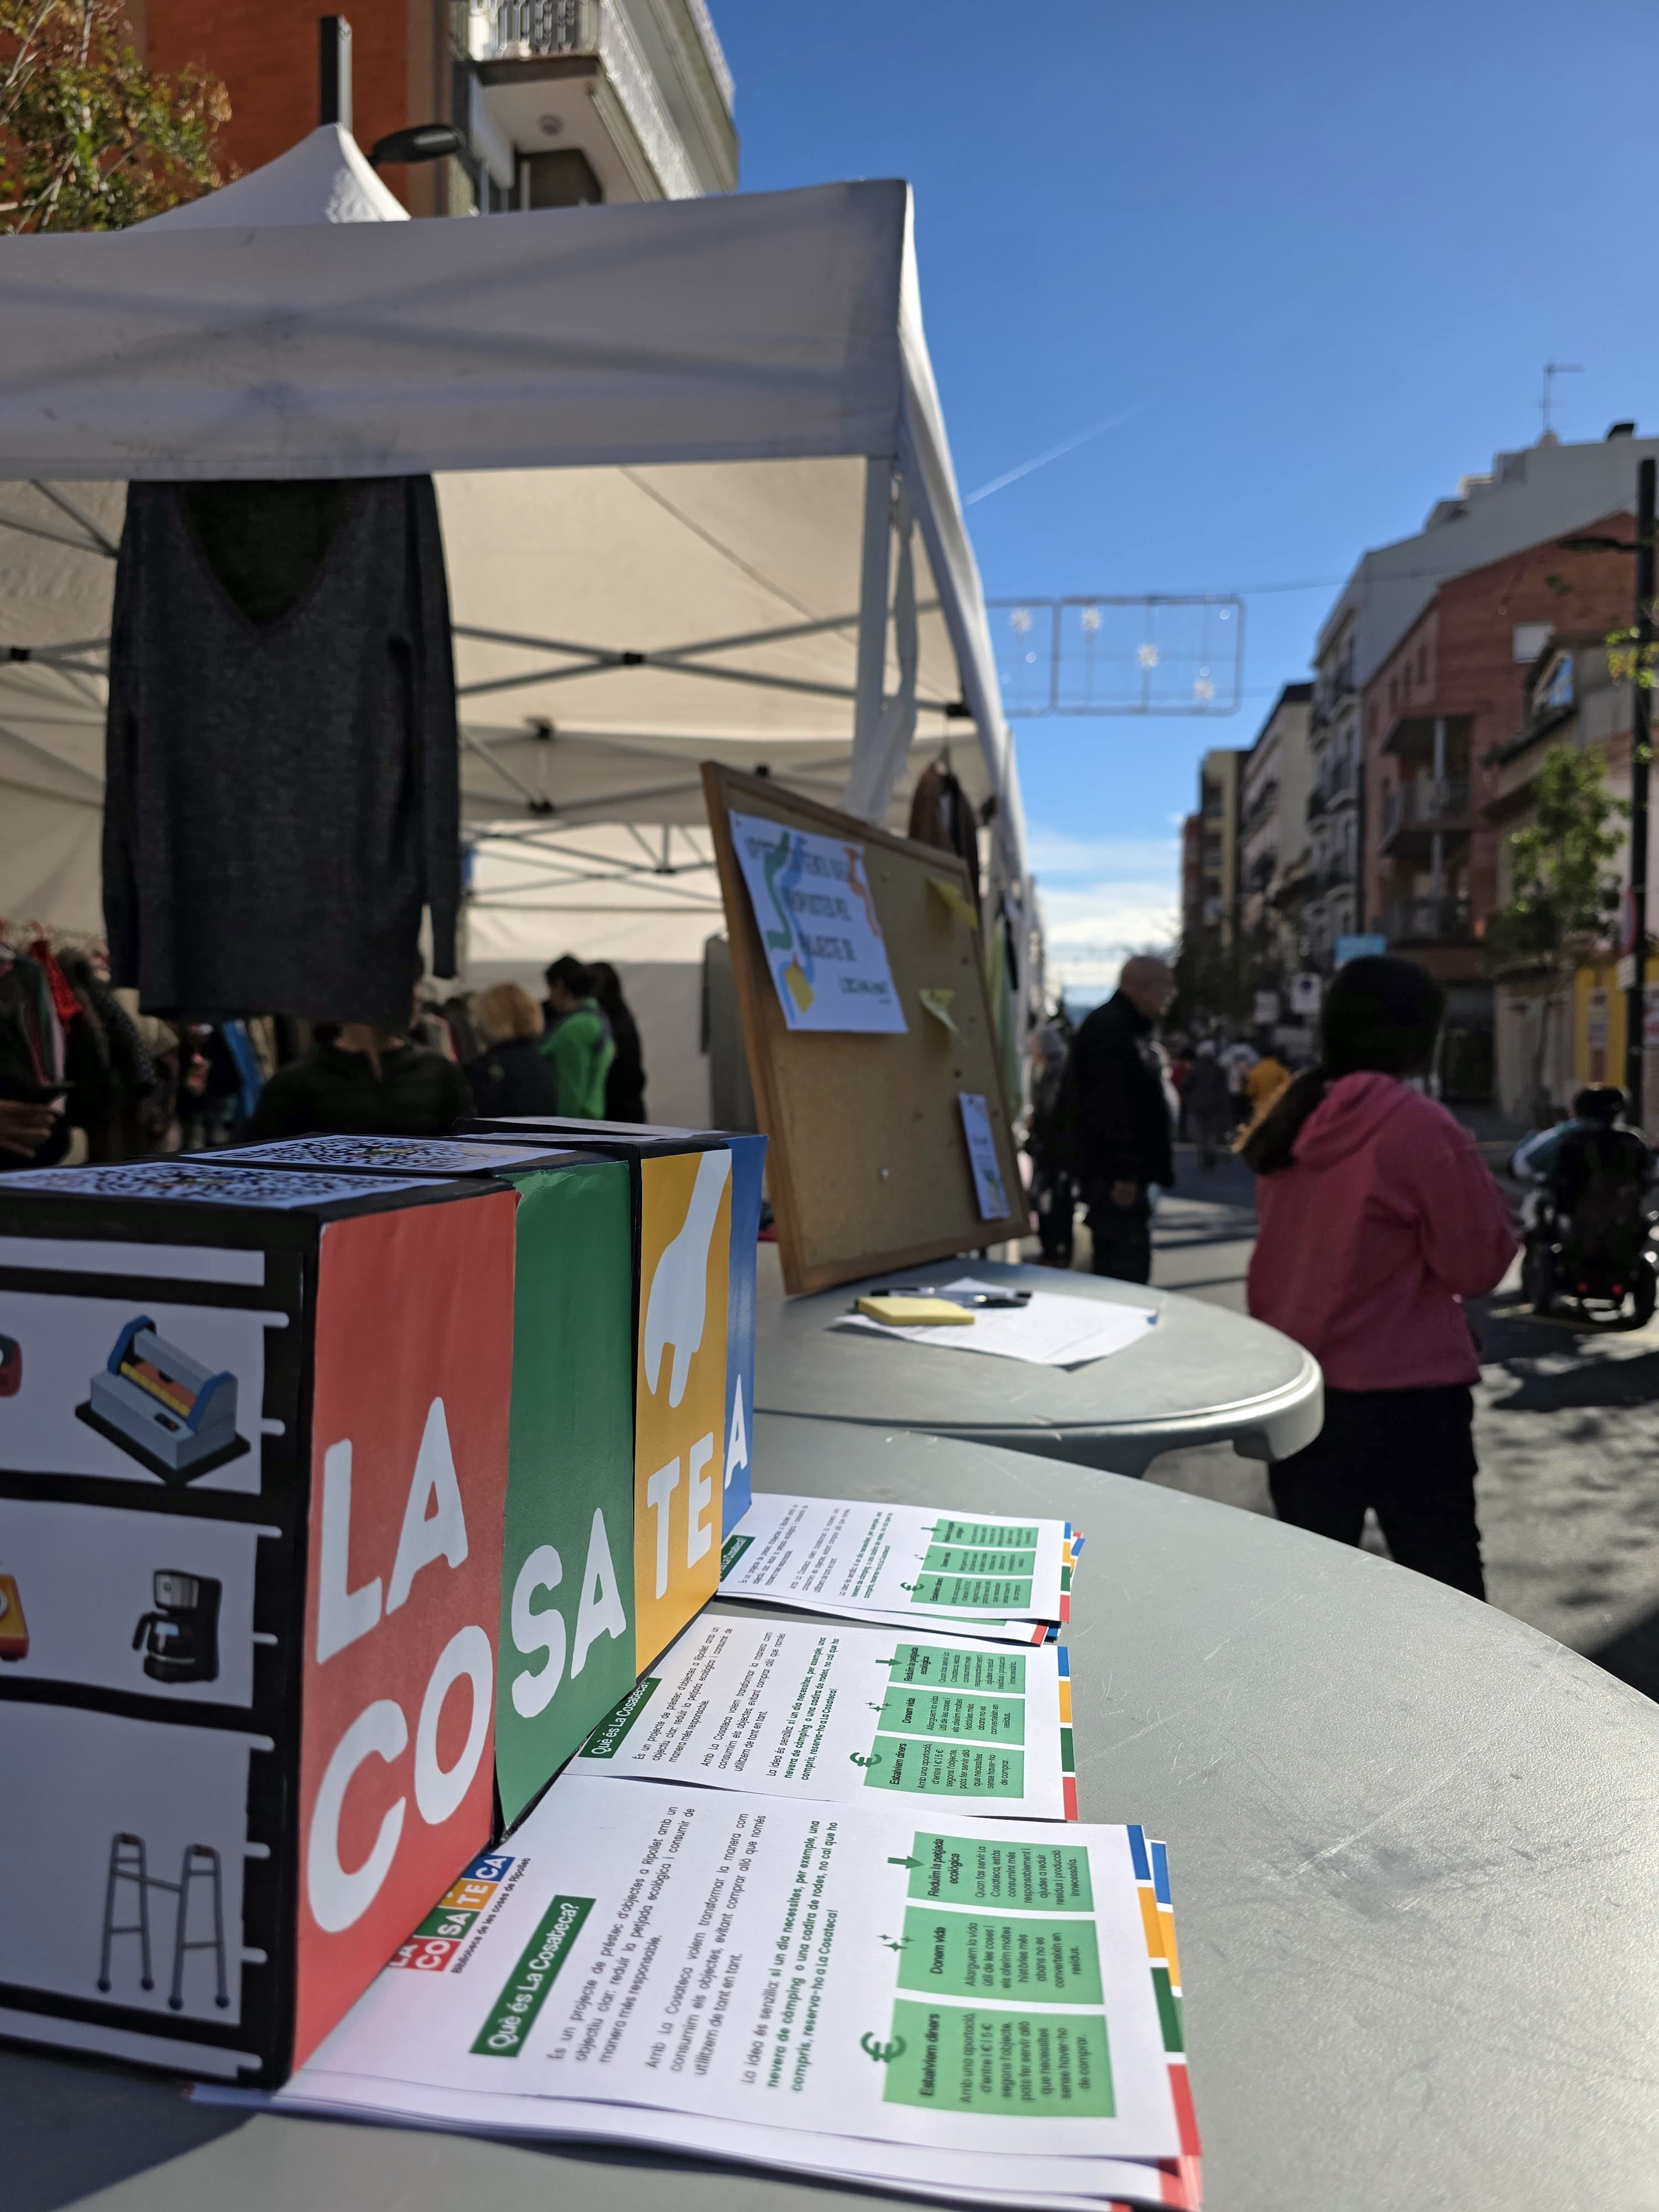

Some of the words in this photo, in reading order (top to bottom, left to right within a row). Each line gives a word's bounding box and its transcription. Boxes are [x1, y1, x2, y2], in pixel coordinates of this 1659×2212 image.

[316, 1396, 468, 1664] LA
[307, 1626, 494, 1934] CO
[511, 1507, 627, 1719] SA
[647, 1432, 714, 1600] TE
[905, 1698, 915, 1707] vida
[608, 1718, 627, 1727] La
[901, 1707, 913, 1723] Donem
[602, 1728, 620, 1738] és
[591, 1739, 613, 1754] Què
[669, 1741, 687, 1762] manera
[681, 1730, 693, 1741] més
[895, 1743, 907, 1759] diners
[961, 1749, 970, 1758] allò
[889, 1759, 904, 1785] Estalviem
[960, 1757, 969, 1771] servir
[974, 1753, 983, 1777] necessites
[986, 1754, 996, 1775] haver-ho
[916, 1777, 926, 1789] Amb
[931, 1767, 941, 1785] d'entre
[946, 1769, 956, 1787] segons
[959, 1778, 969, 1789] pots
[973, 1777, 983, 1787] que
[735, 1813, 749, 1828] com
[750, 1815, 766, 1838] només
[808, 1820, 820, 1834] una
[826, 1822, 838, 1831] ho
[723, 1833, 742, 1861] manera
[745, 1841, 758, 1855] que
[825, 1833, 837, 1846] que
[800, 1836, 817, 1868] exemple,
[821, 1848, 832, 1859] cal
[932, 1838, 946, 1863] petjada
[976, 1853, 985, 1869] servir
[990, 1849, 1001, 1865] estàs
[1006, 1851, 1016, 1864] més
[508, 1858, 531, 1882] Ripollet
[738, 1858, 752, 1871] allò
[818, 1861, 828, 1871] no
[947, 1853, 963, 1884] ecològica
[1036, 1854, 1047, 1871] reduir
[1051, 1850, 1066, 1879] producció
[795, 1870, 808, 1884] per
[812, 1873, 827, 1897] rodes,
[927, 1870, 941, 1897] Reduïm
[975, 1870, 985, 1880] fas
[990, 1866, 1001, 1897] Cosateca,
[1006, 1865, 1016, 1897] consumint
[1021, 1851, 1035, 1903] responsablement
[1067, 1858, 1080, 1896] innecessària.
[504, 1883, 515, 1891] de
[726, 1875, 745, 1909] comprar
[974, 1881, 986, 1898] Quan
[1037, 1877, 1051, 1898] ajudes
[1053, 1882, 1065, 1905] residus
[492, 1893, 509, 1912] coses
[697, 1878, 724, 1926] transformar
[782, 1886, 805, 1933] necessites,
[807, 1900, 820, 1910] de
[415, 1940, 451, 1969] CO
[437, 1913, 472, 1936] SA
[456, 1884, 489, 1904] TE
[476, 1858, 508, 1879] CA
[482, 1914, 496, 1924] les
[477, 1926, 488, 1934] de
[528, 1902, 579, 1970] Cosateca?
[547, 2048, 566, 2059] És
[561, 2027, 576, 2041] un
[570, 1980, 597, 2021] projecte
[591, 1961, 606, 1974] de
[600, 1924, 624, 1957] préstec
[617, 1878, 645, 1919] d'objectes
[641, 1838, 663, 1865] Ripollet
[658, 1819, 672, 1835] amb
[666, 1807, 678, 1815] un
[576, 2018, 603, 2060] objectiu
[609, 1957, 630, 1984] reduir
[621, 1943, 636, 1952] la
[630, 1905, 653, 1938] petjada
[647, 1863, 671, 1901] ecològica
[668, 1820, 690, 1853] consumir
[682, 1808, 695, 1817] de
[714, 1913, 733, 1943] evitant
[802, 1912, 817, 1941] cadira
[818, 1909, 838, 1954] Cosateca!
[933, 1927, 946, 1943] vida
[687, 1932, 706, 1959] volem
[776, 1936, 790, 1950] dia
[797, 1943, 810, 1961] una
[389, 1944, 419, 1967] LA
[451, 1936, 482, 1973] Biblioteca
[725, 1954, 742, 1974] tant.
[774, 1953, 786, 1965] un
[815, 1956, 828, 1966] La
[930, 1944, 945, 1974] Donem
[698, 1948, 723, 1989] objectes,
[769, 1968, 782, 1977] si
[517, 1973, 544, 1991] La
[665, 1967, 693, 2014] Cosateca
[722, 1976, 735, 1989] en
[506, 1994, 533, 2013] és
[599, 2020, 627, 2063] manera
[619, 1996, 637, 2017] més
[628, 1935, 661, 1994] responsable.
[692, 1995, 706, 2008] els
[713, 1990, 731, 2011] tant
[760, 1980, 779, 2019] senzilla:
[781, 1977, 806, 2024] càmping
[802, 1976, 825, 2036] reserva-ho
[658, 2022, 673, 2034] La
[708, 2013, 723, 2027] de
[753, 2023, 768, 2036] és
[925, 2013, 940, 2043] diners
[487, 2016, 521, 2048] Què
[776, 2027, 790, 2042] de
[670, 2015, 699, 2072] consumim
[695, 2030, 718, 2075] utilitzem
[747, 2041, 764, 2065] idea
[645, 2042, 666, 2068] Amb
[791, 2039, 812, 2091] compris,
[740, 2070, 757, 2084] La
[767, 2046, 786, 2087] nevera
[919, 2044, 937, 2096] Estalviem
